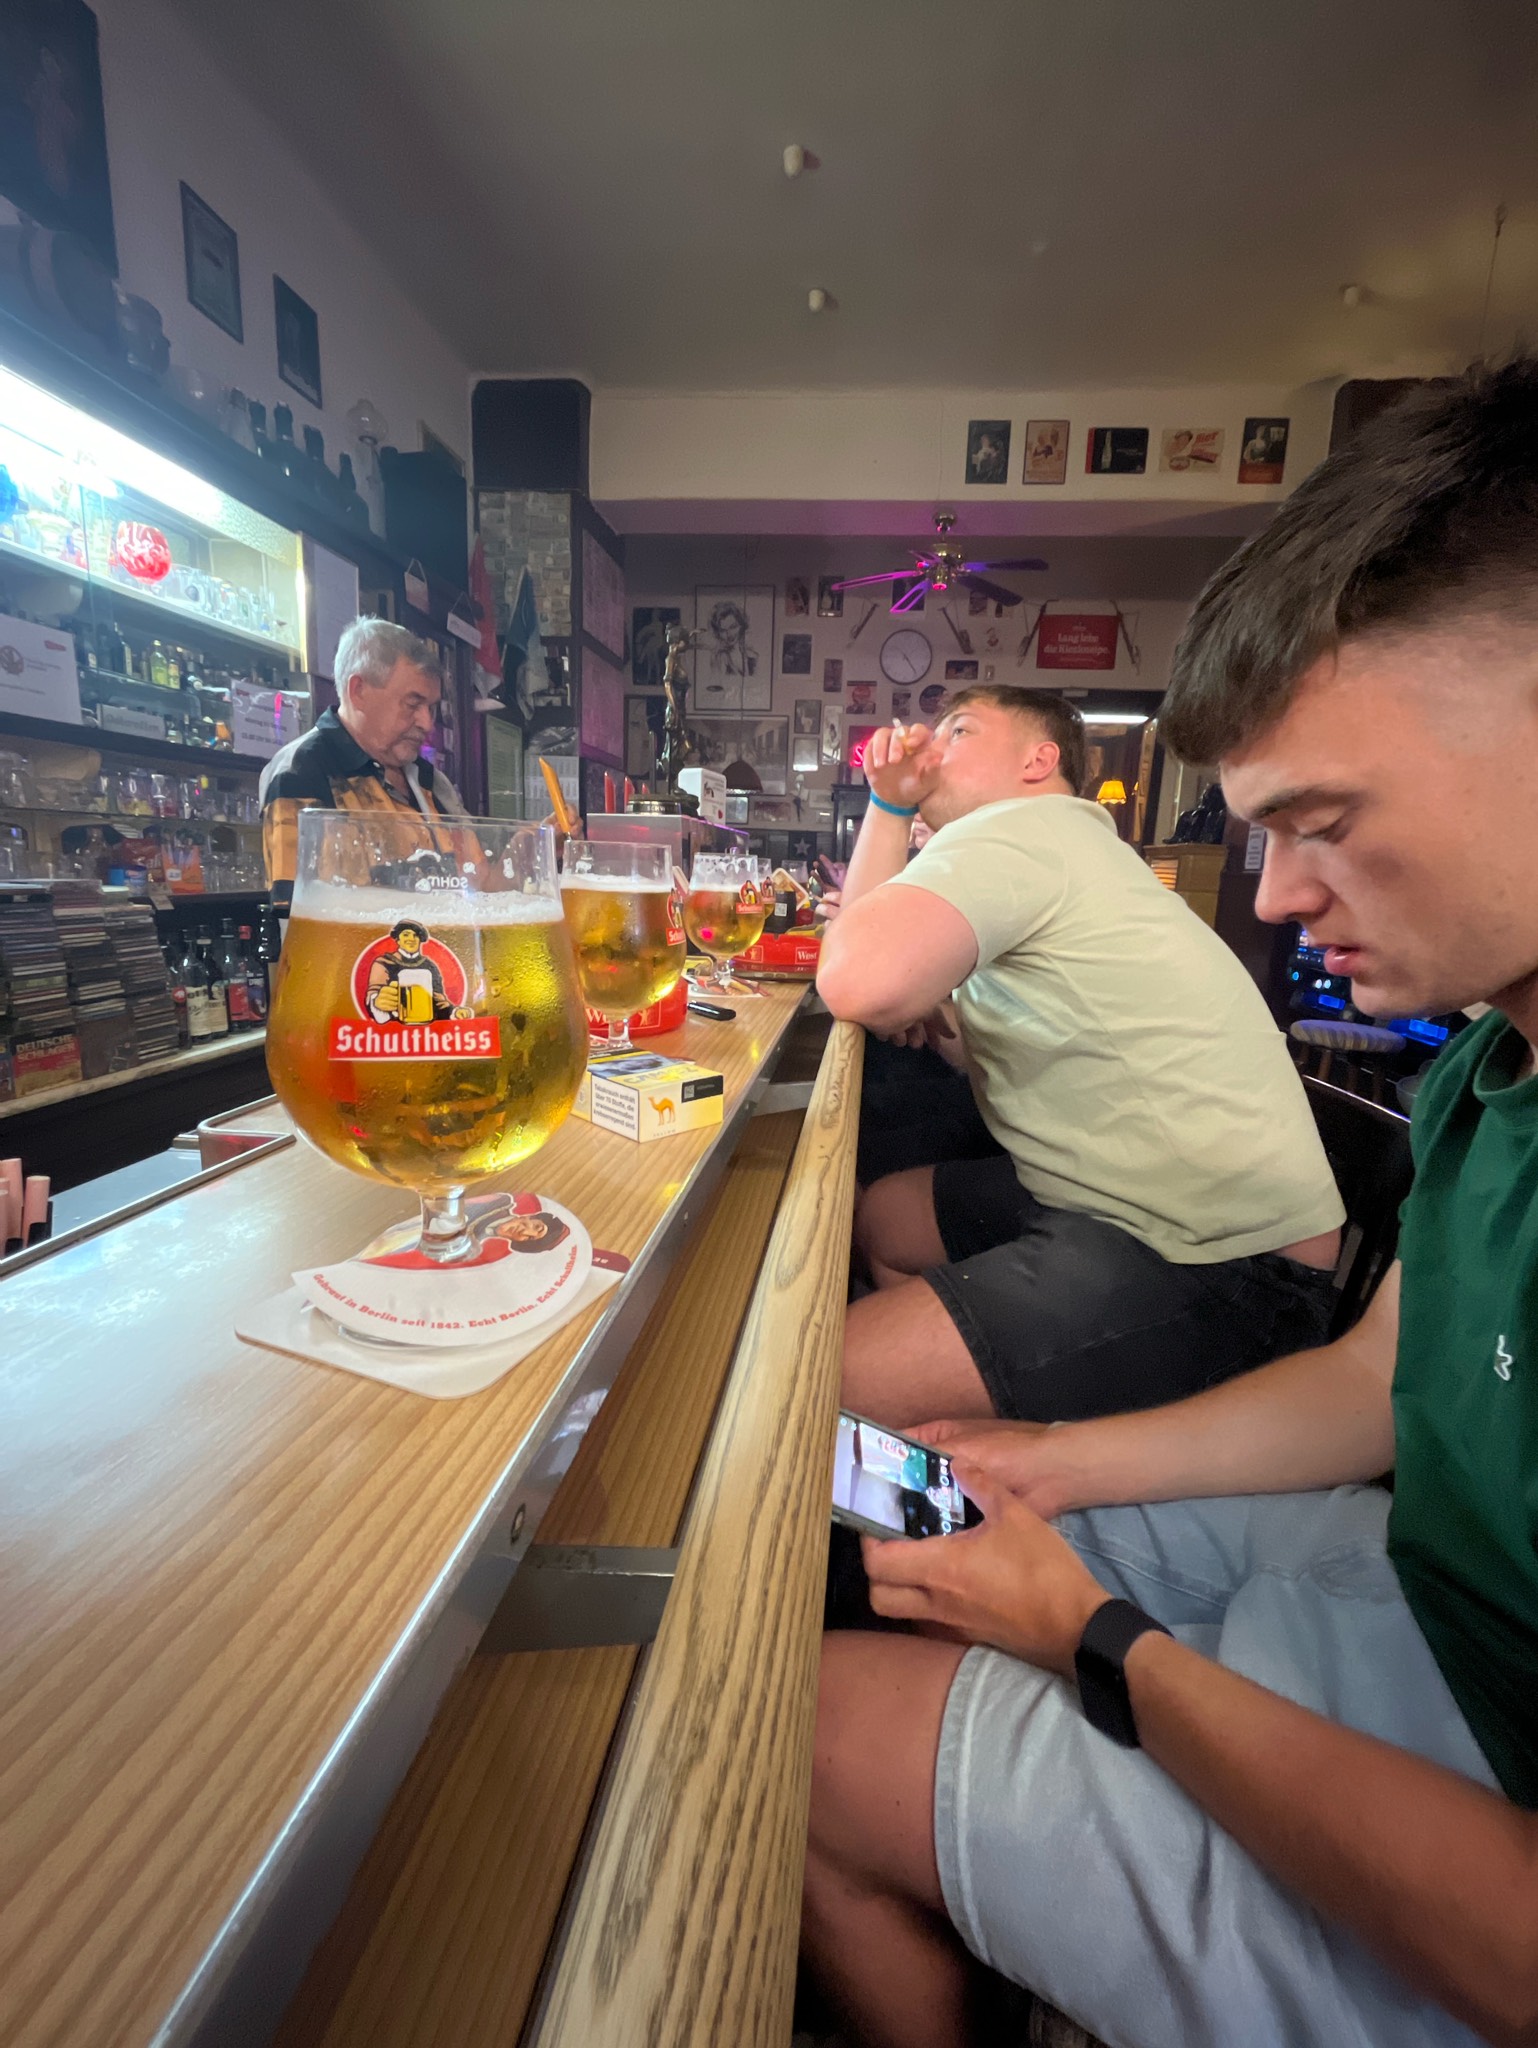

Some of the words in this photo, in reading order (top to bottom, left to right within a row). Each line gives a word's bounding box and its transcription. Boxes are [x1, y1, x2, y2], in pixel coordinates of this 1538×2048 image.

[16, 1033, 74, 1053] DEUTSCHE
[336, 1024, 492, 1054] Schultheiss
[18, 1043, 76, 1062] SCHLAGER
[313, 1274, 346, 1301] Gebraut
[344, 1298, 357, 1308] in
[359, 1305, 398, 1322] Berlin
[401, 1319, 426, 1327] seit
[468, 1318, 497, 1328] Echt
[499, 1304, 538, 1321] Berlin.
[536, 1287, 558, 1303] Echt
